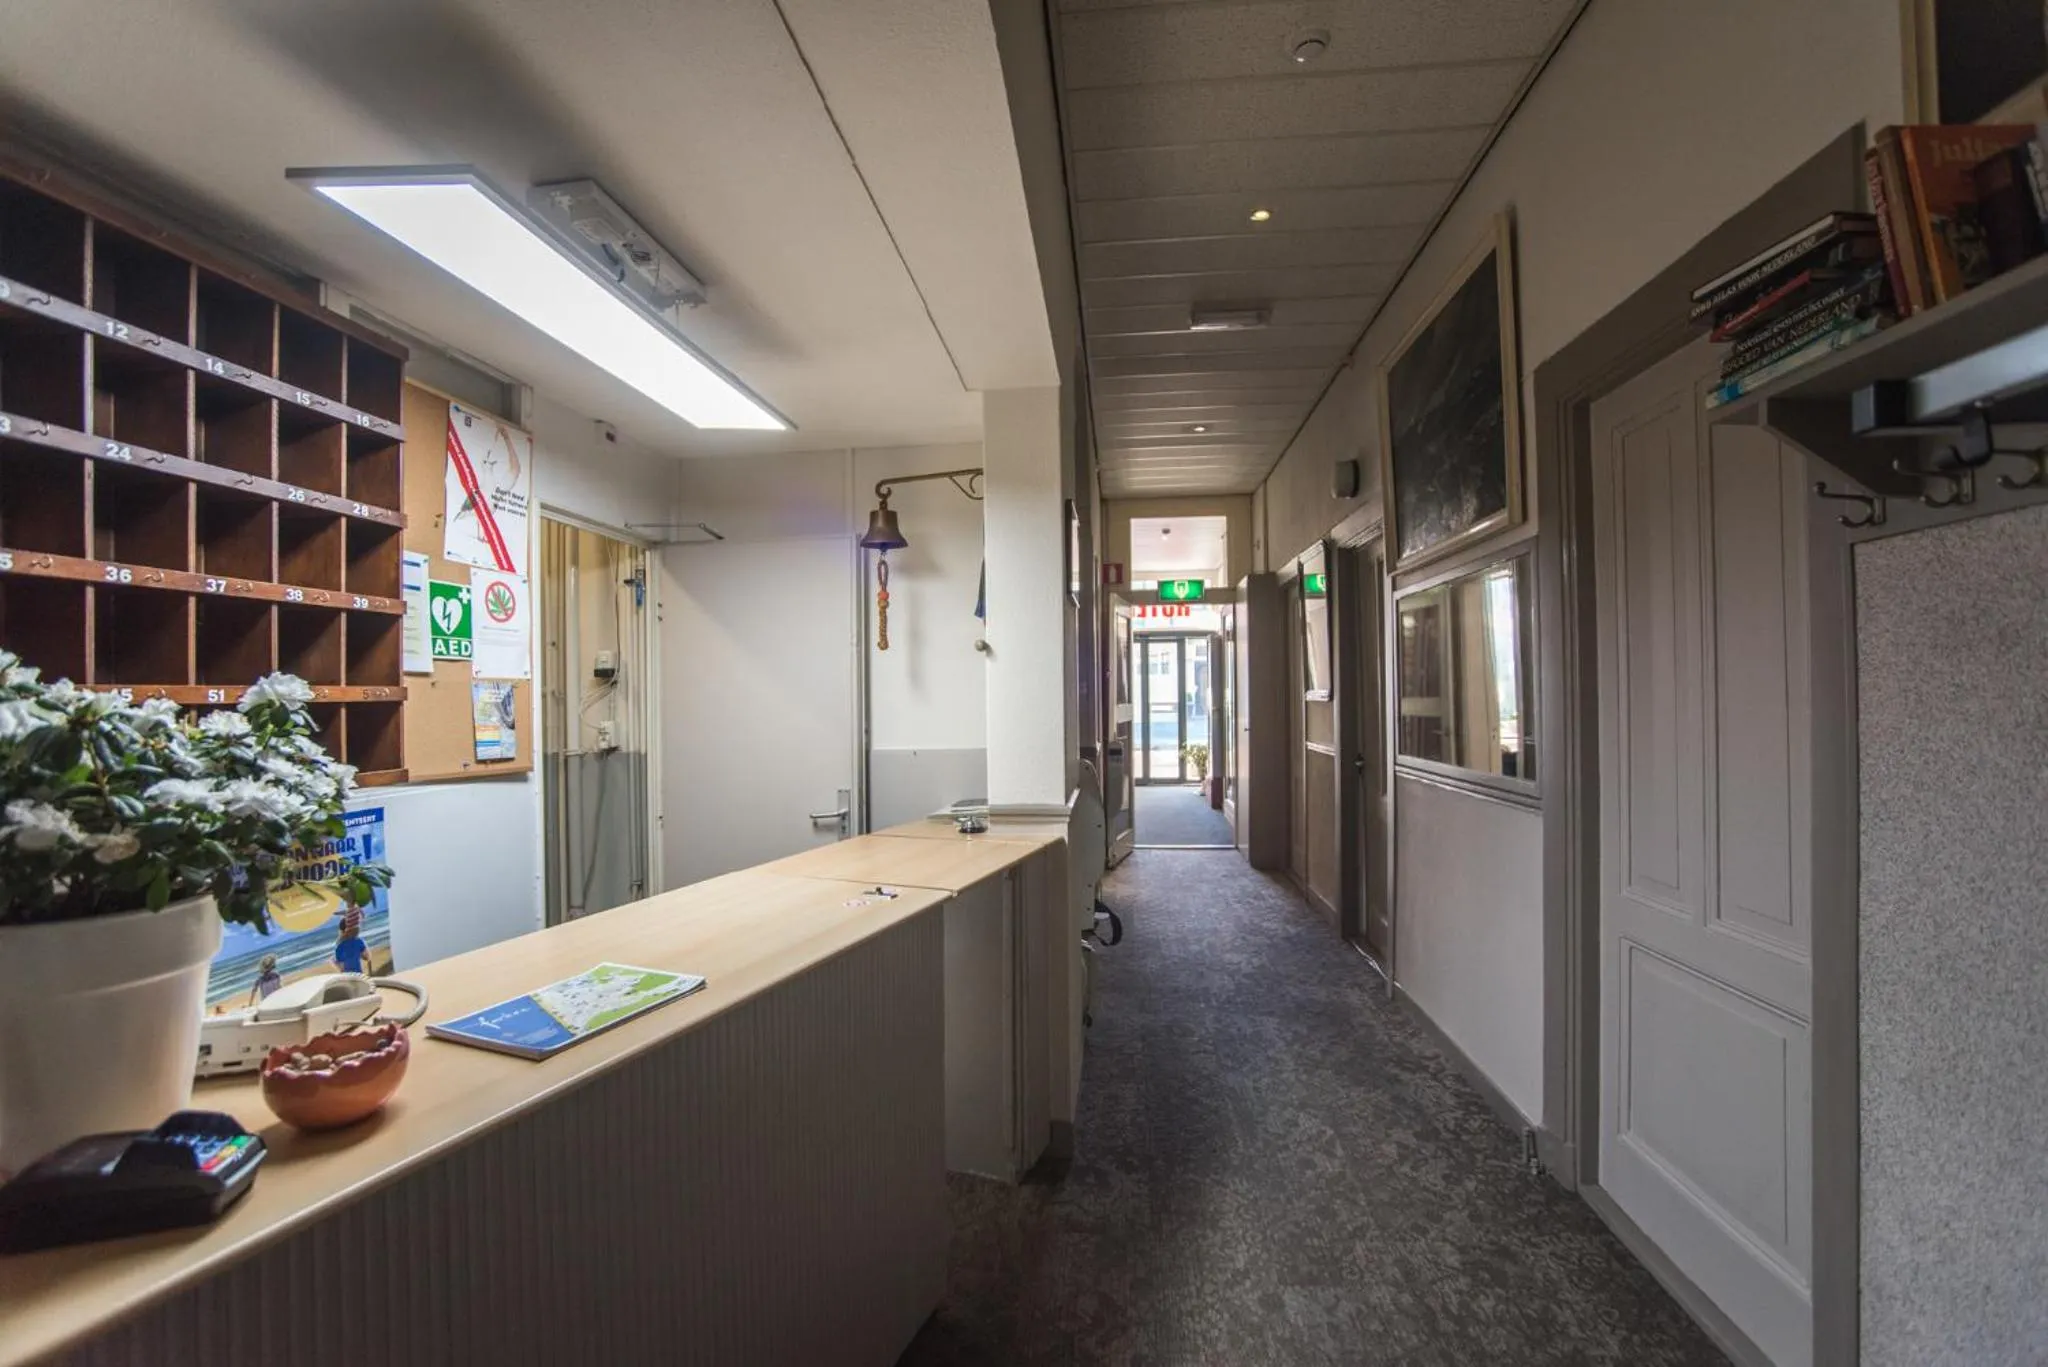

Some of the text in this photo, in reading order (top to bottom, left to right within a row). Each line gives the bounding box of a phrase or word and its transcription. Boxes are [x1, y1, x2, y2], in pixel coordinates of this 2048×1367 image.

[104, 320, 129, 339] 12
[205, 357, 226, 375] 14
[296, 391, 311, 405] 15
[106, 442, 133, 462] 24
[353, 503, 369, 517] 28
[105, 566, 132, 583] 36
[206, 578, 227, 593] 37
[286, 588, 303, 602] 38
[353, 596, 369, 609] 39
[434, 637, 472, 657] AED
[208, 689, 225, 702] 51
